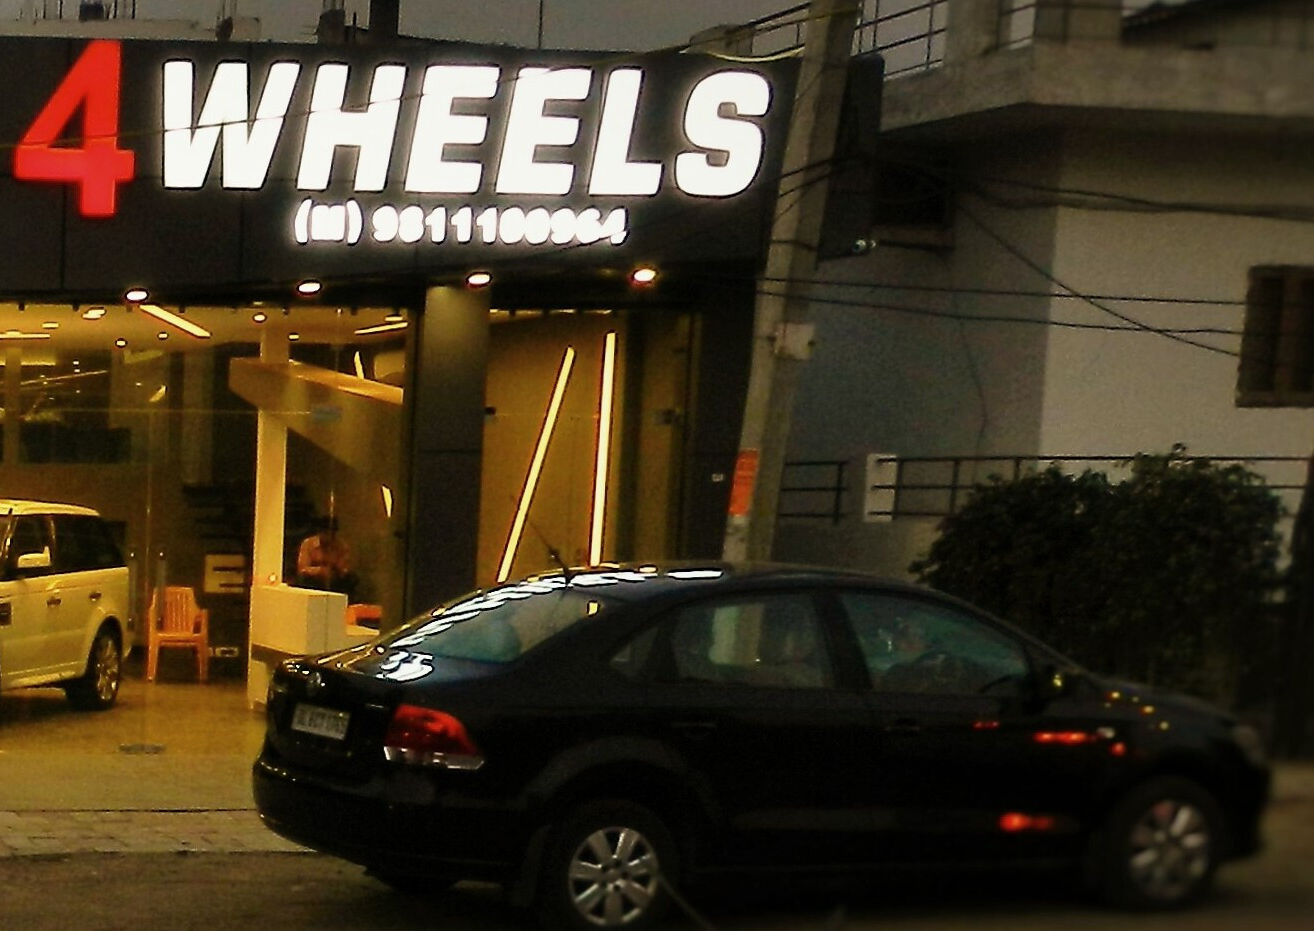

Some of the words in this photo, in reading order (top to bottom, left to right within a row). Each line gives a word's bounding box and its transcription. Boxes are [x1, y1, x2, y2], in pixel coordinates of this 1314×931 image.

[14, 39, 135, 217] 4
[162, 60, 773, 198] WHEELS
[294, 199, 362, 244] (M)
